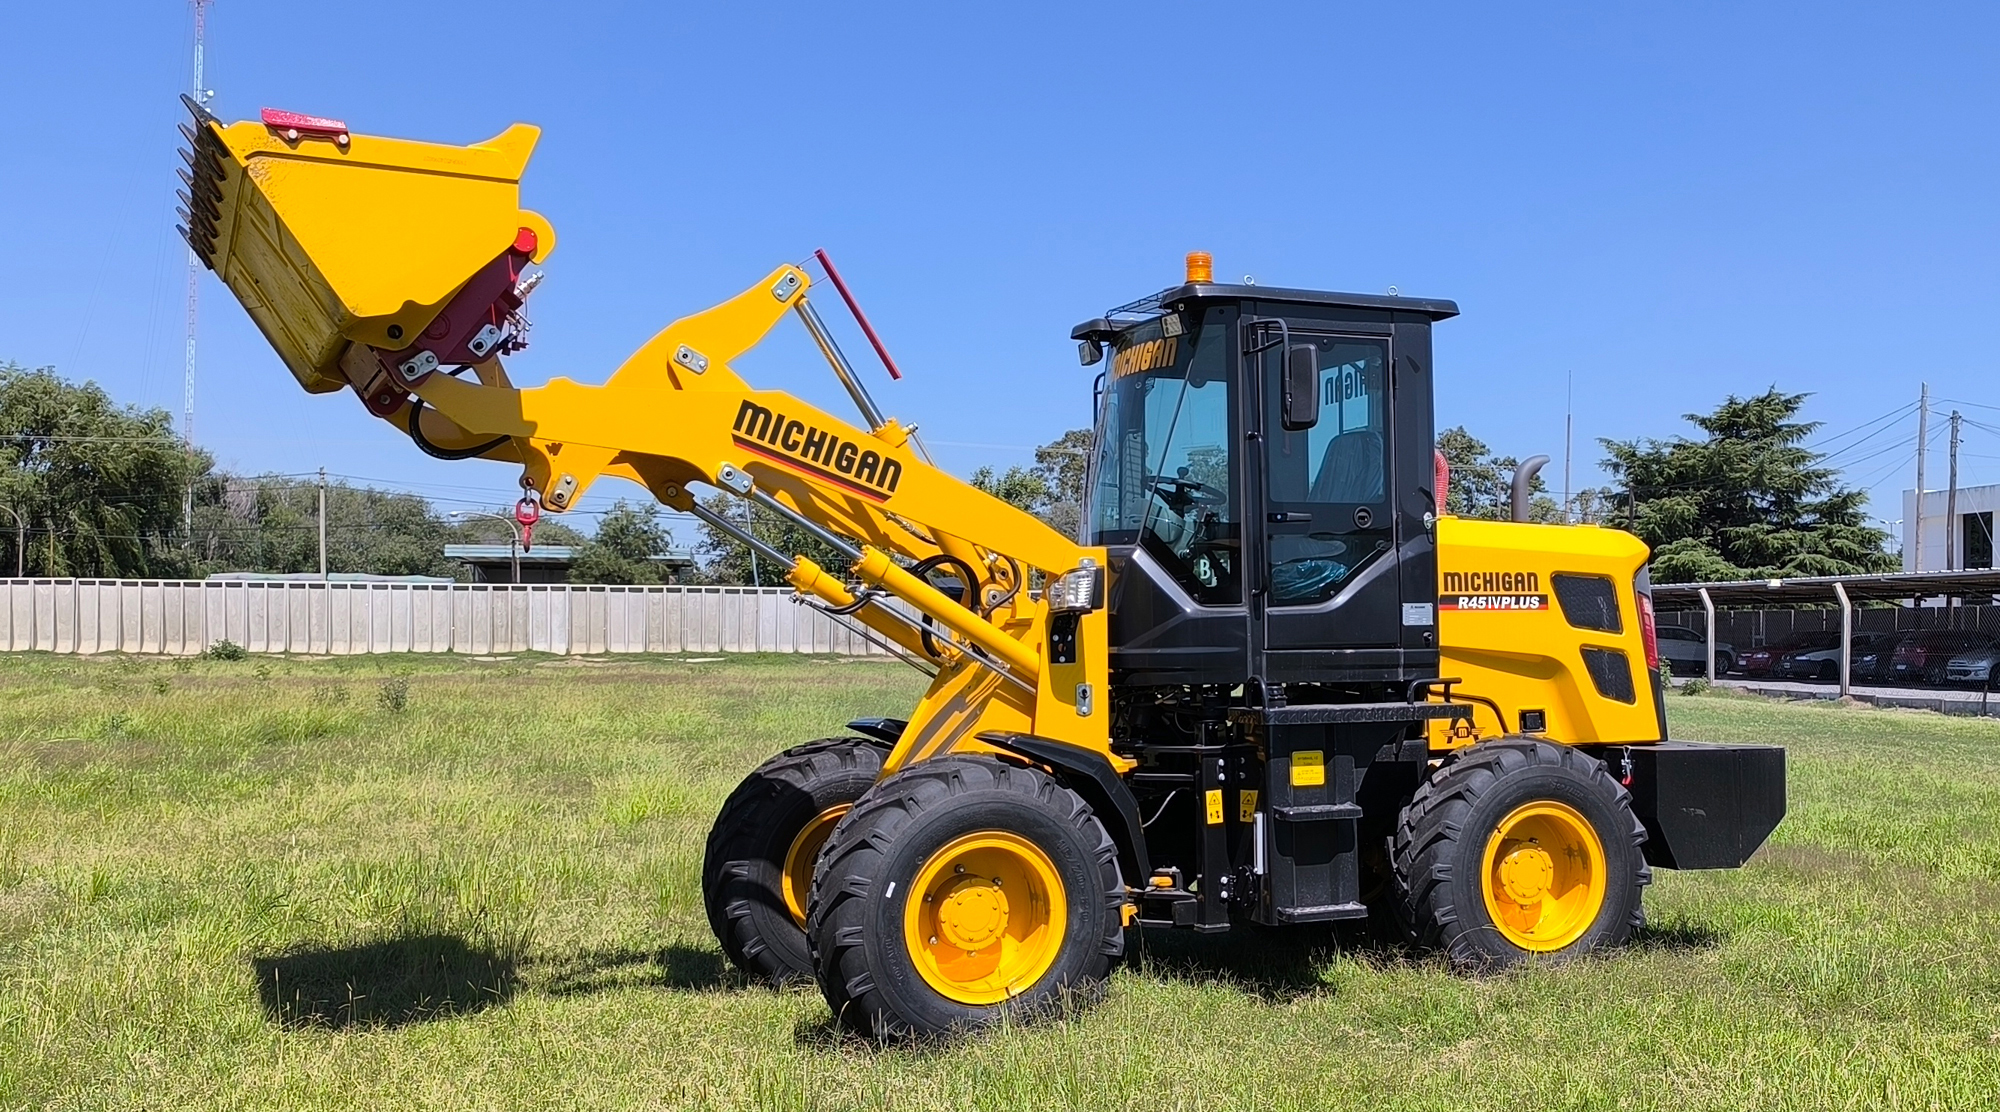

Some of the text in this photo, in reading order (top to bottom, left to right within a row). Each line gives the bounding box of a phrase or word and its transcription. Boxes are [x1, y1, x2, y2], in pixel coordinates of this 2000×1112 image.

[1113, 337, 1178, 380] MICHIGAN
[732, 399, 902, 493] MICHIGAN
[1443, 572, 1539, 592] MICHIGAN
